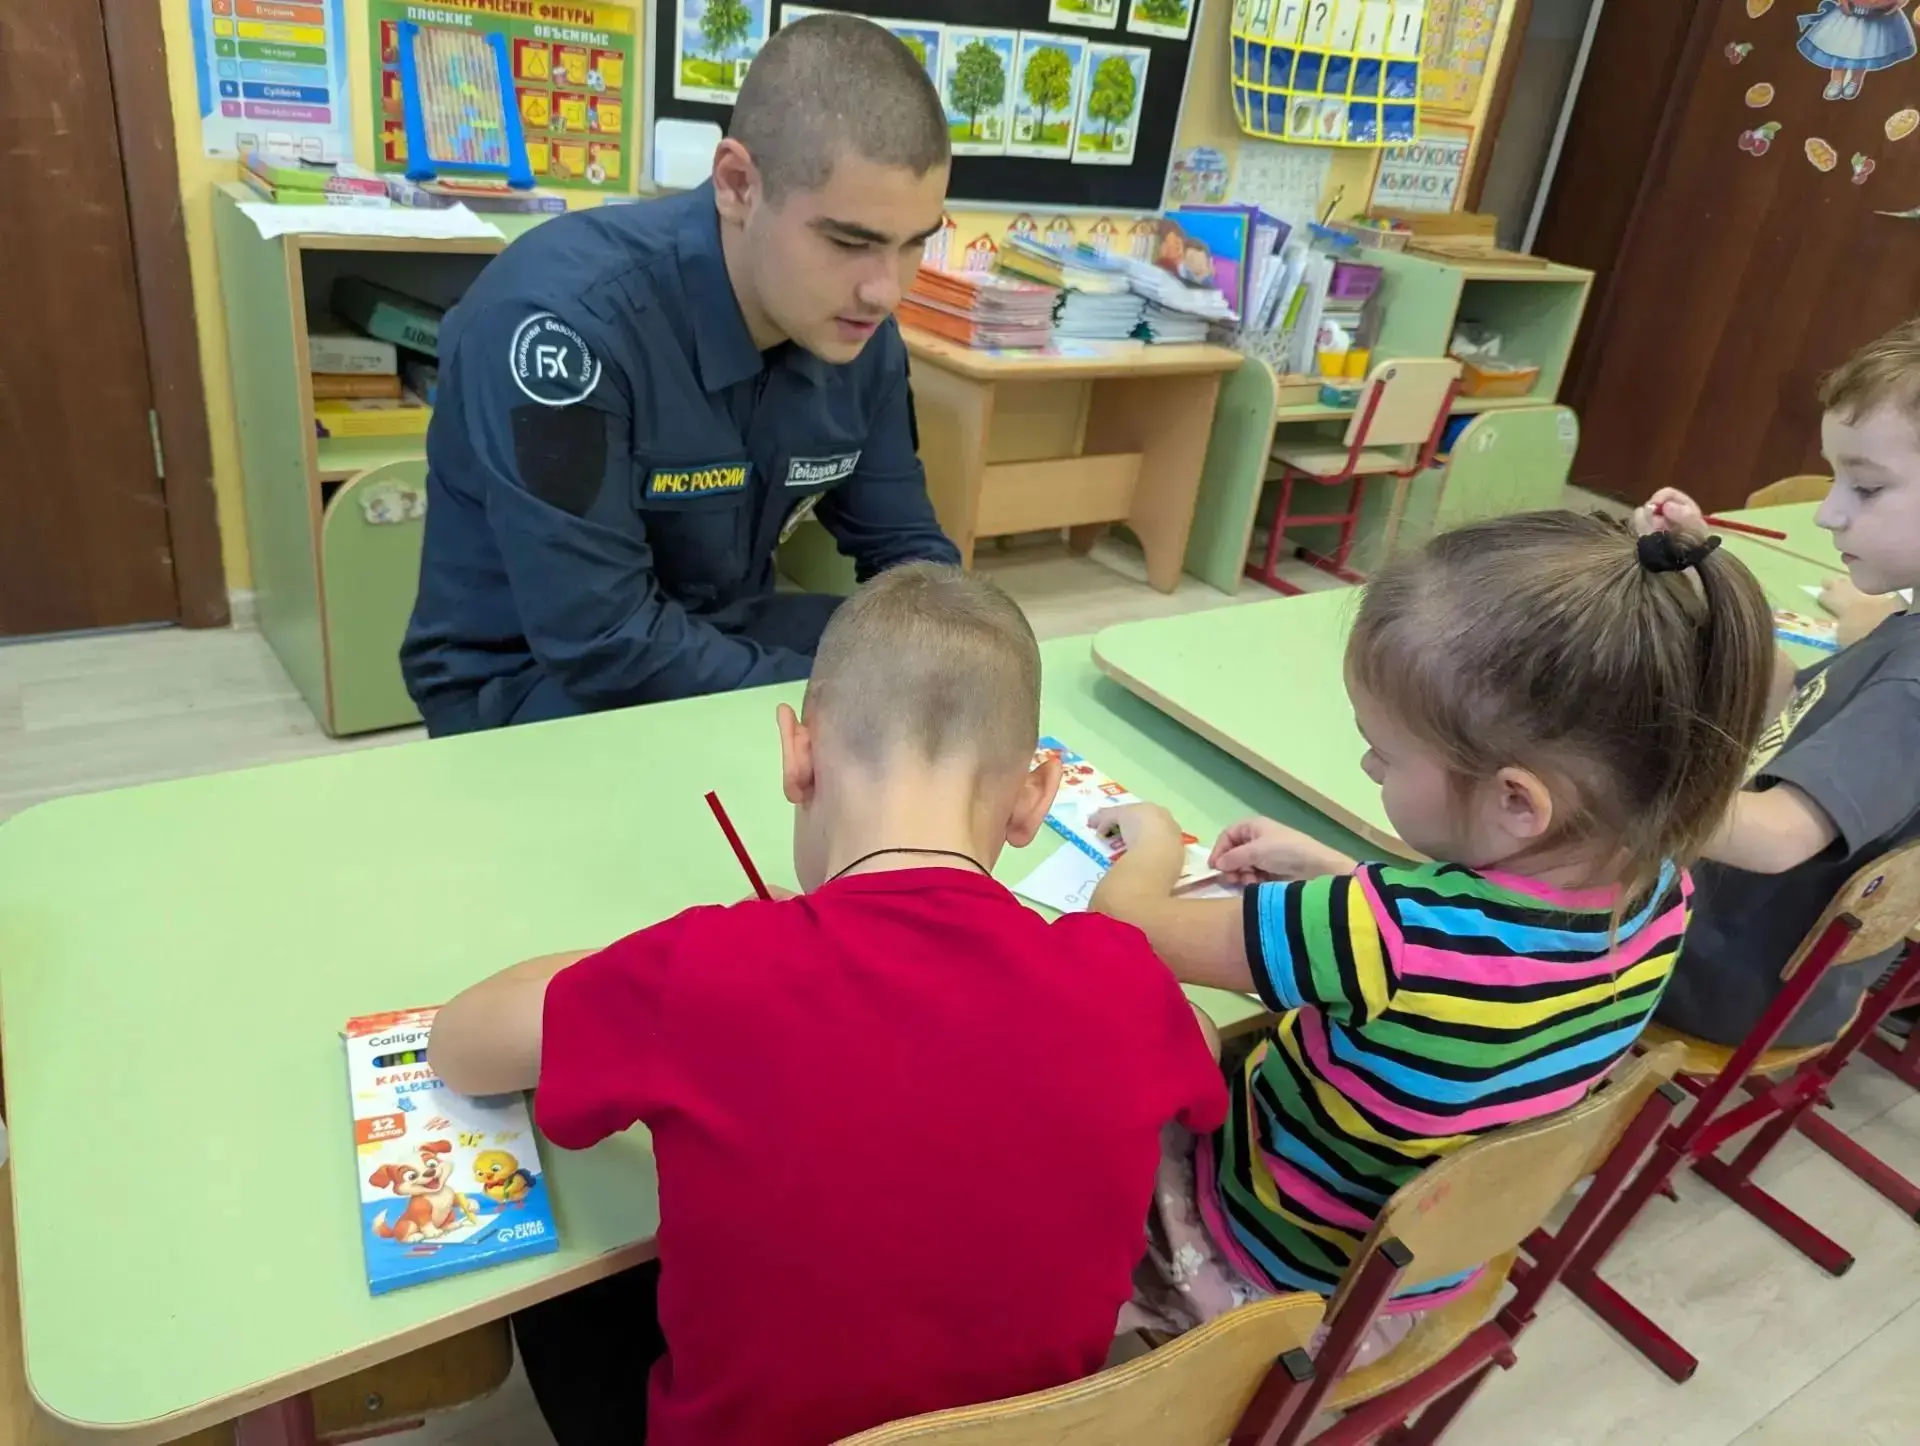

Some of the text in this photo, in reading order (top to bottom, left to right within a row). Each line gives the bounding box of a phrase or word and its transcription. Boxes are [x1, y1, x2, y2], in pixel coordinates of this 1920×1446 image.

[407, 6, 473, 26] ПЛОСКИЕ
[539, 5, 594, 25] ФИГУРЫ
[652, 467, 746, 493] МЧС РОССИИ
[371, 1117, 397, 1133] 12
[513, 1219, 543, 1233] SIMA
[515, 1226, 545, 1240] LAND
